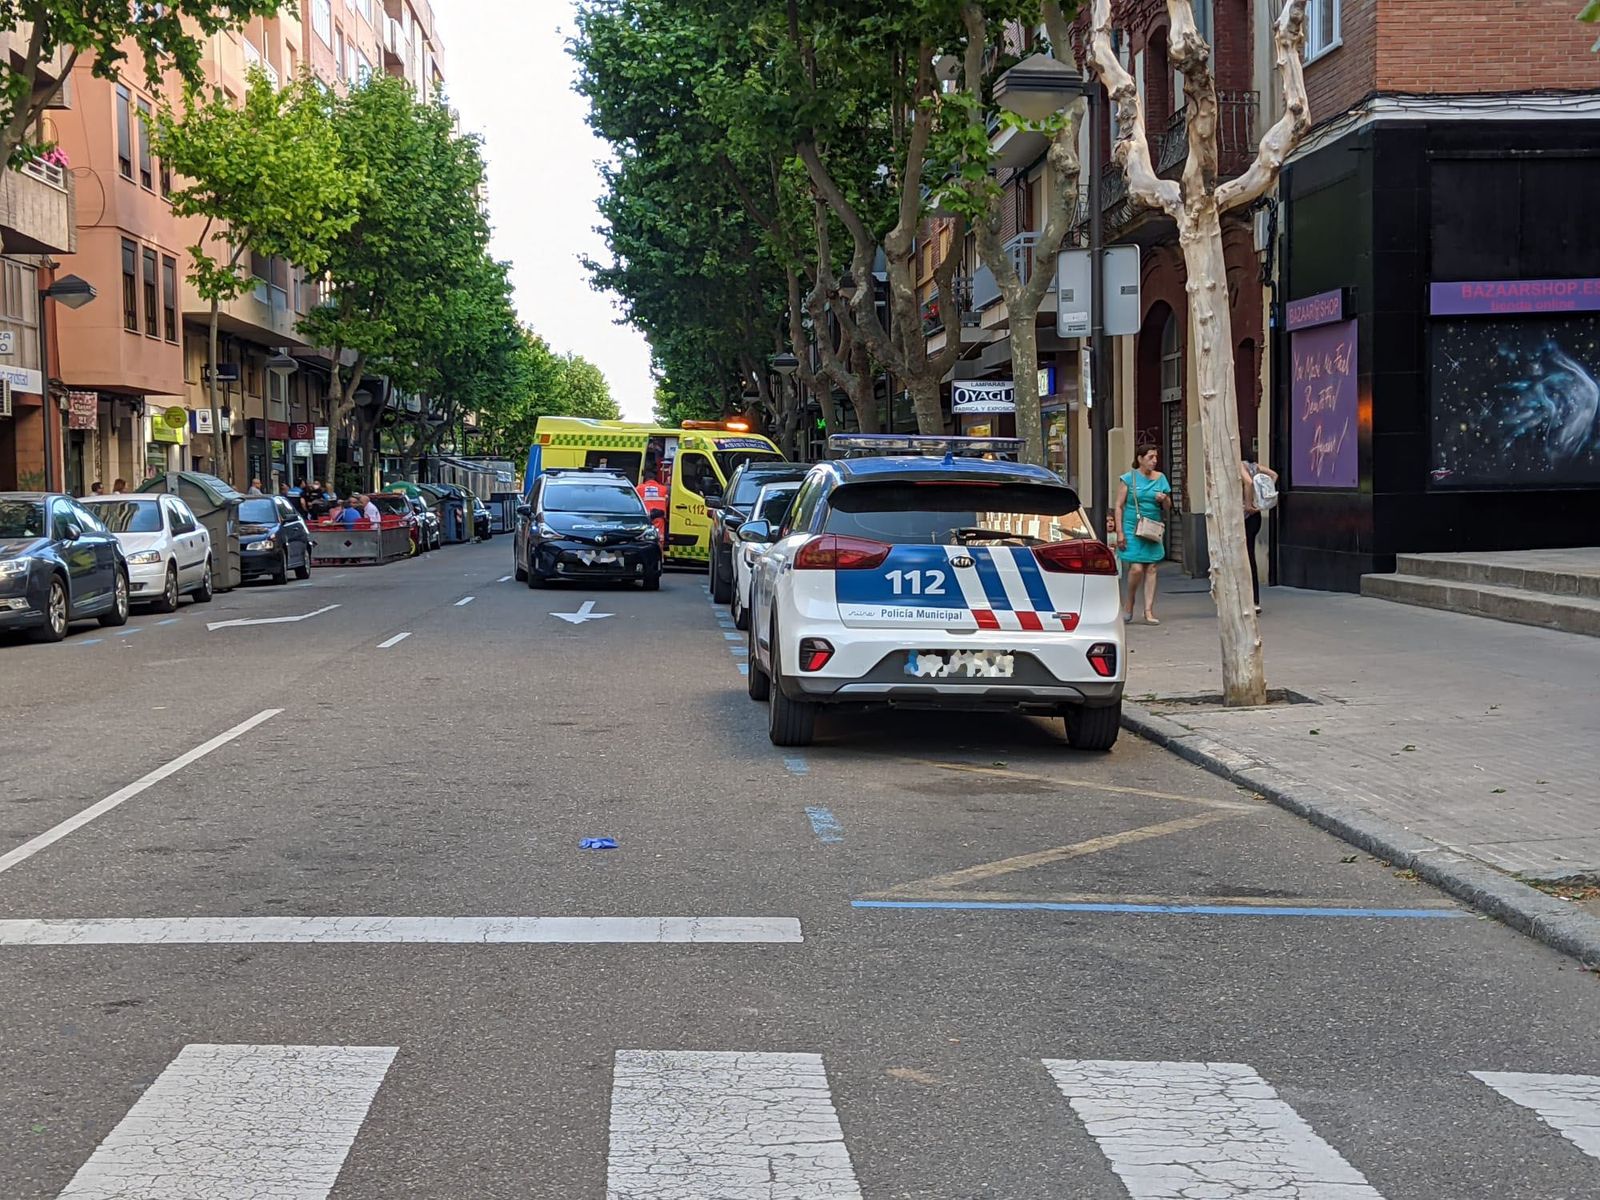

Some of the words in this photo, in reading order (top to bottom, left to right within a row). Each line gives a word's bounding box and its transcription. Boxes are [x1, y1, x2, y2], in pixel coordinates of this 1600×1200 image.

[692, 504, 705, 515] 112
[884, 569, 946, 595] 112
[881, 608, 914, 619] Policía
[916, 611, 963, 622] Municipal
